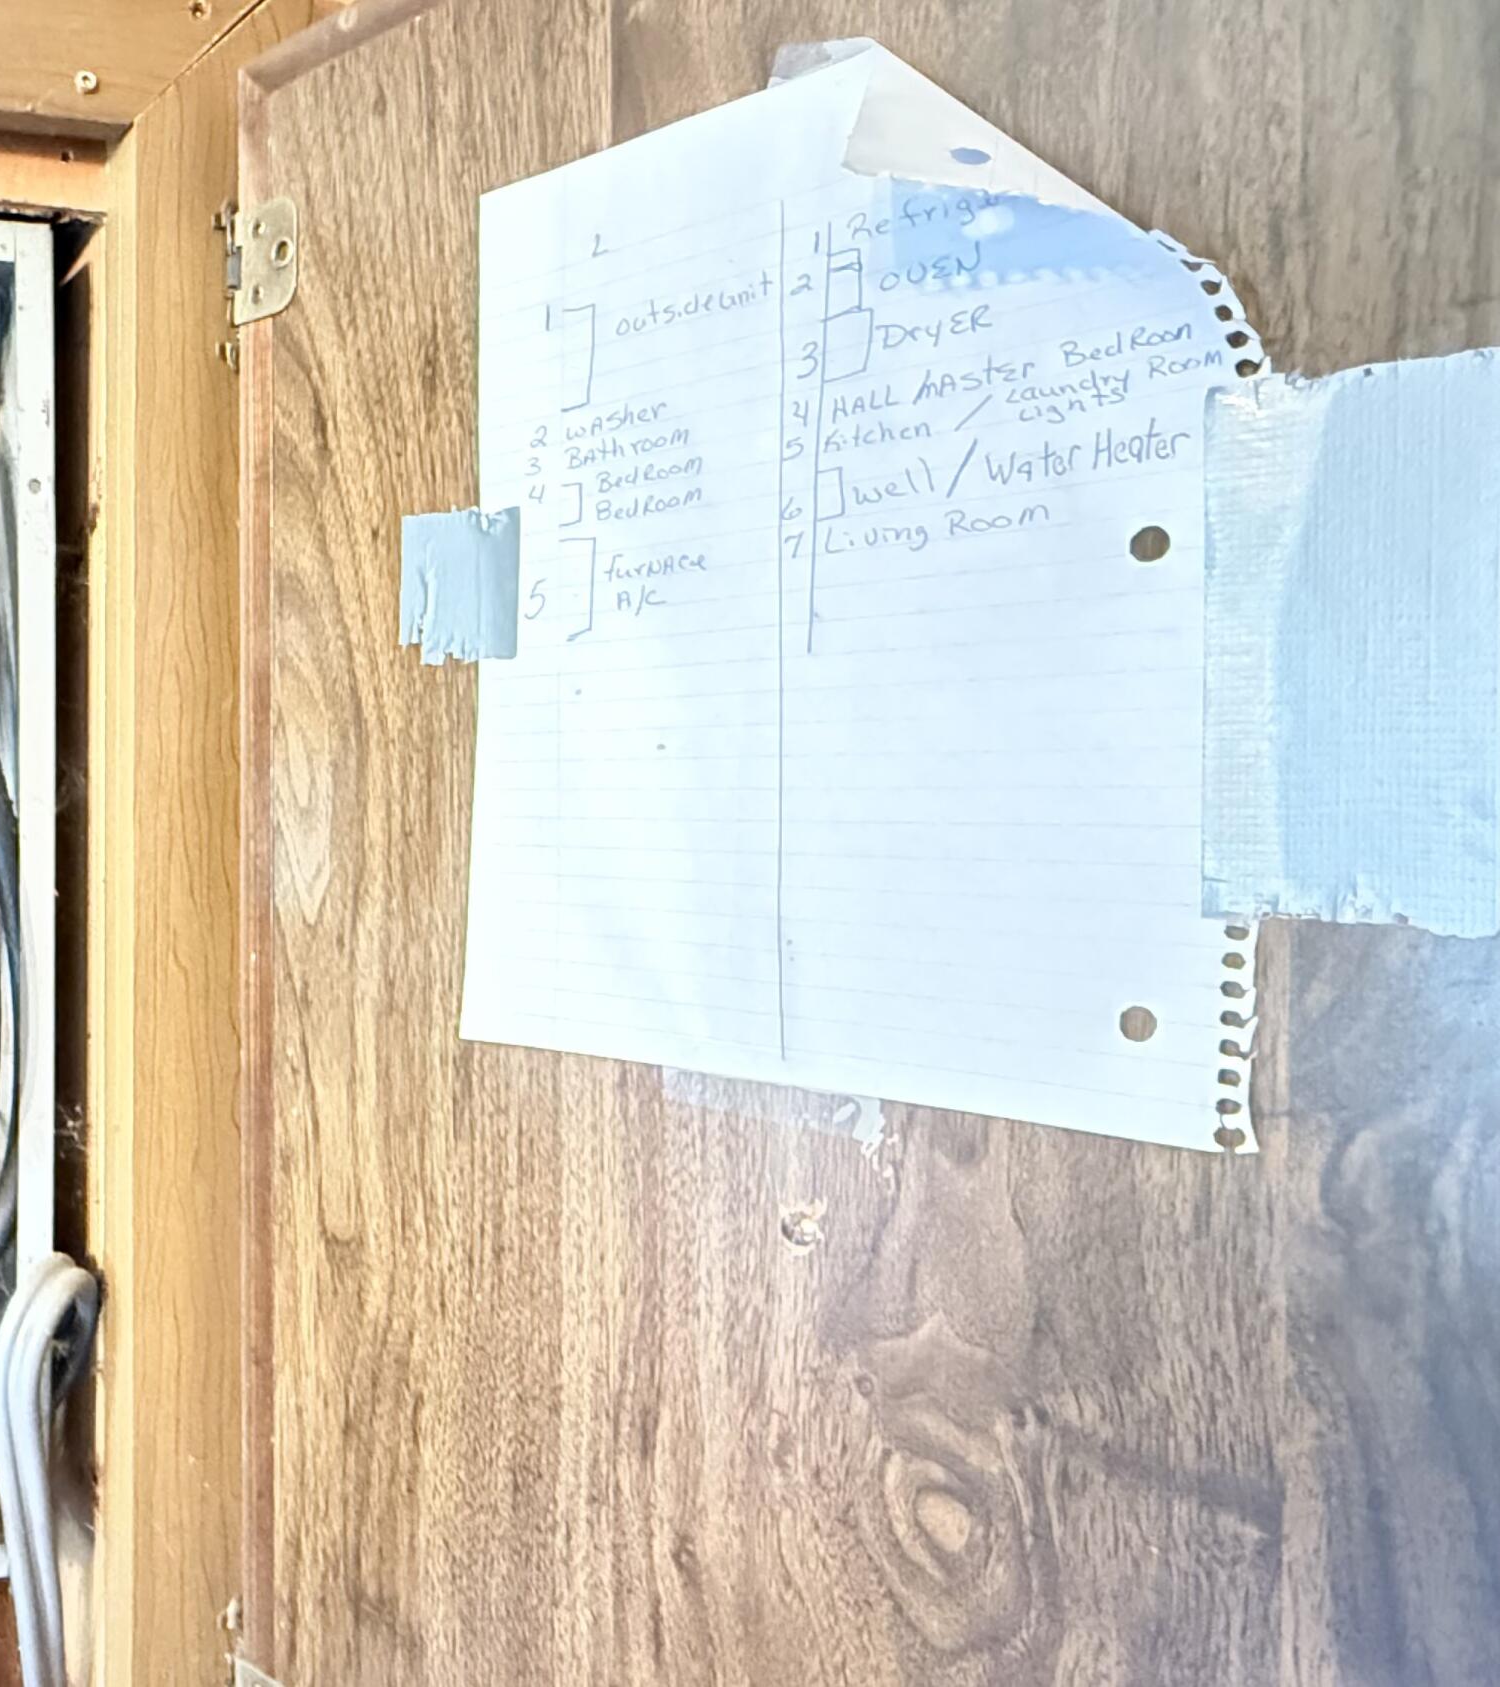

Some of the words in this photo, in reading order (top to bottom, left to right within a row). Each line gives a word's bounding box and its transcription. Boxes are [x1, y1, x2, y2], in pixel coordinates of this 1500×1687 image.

[789, 273, 813, 296] 2
[797, 341, 819, 379] 3
[792, 399, 810, 427] 4
[831, 384, 900, 424] HALL
[530, 425, 548, 448] 2
[782, 436, 805, 461] 5
[525, 456, 542, 477] 3
[781, 496, 803, 521] 6
[985, 441, 1082, 486] Water
[1092, 417, 1192, 471] Heater
[528, 484, 546, 504] 4
[784, 530, 805, 559] 7
[524, 577, 548, 621] 5
[616, 584, 668, 617] A/C
